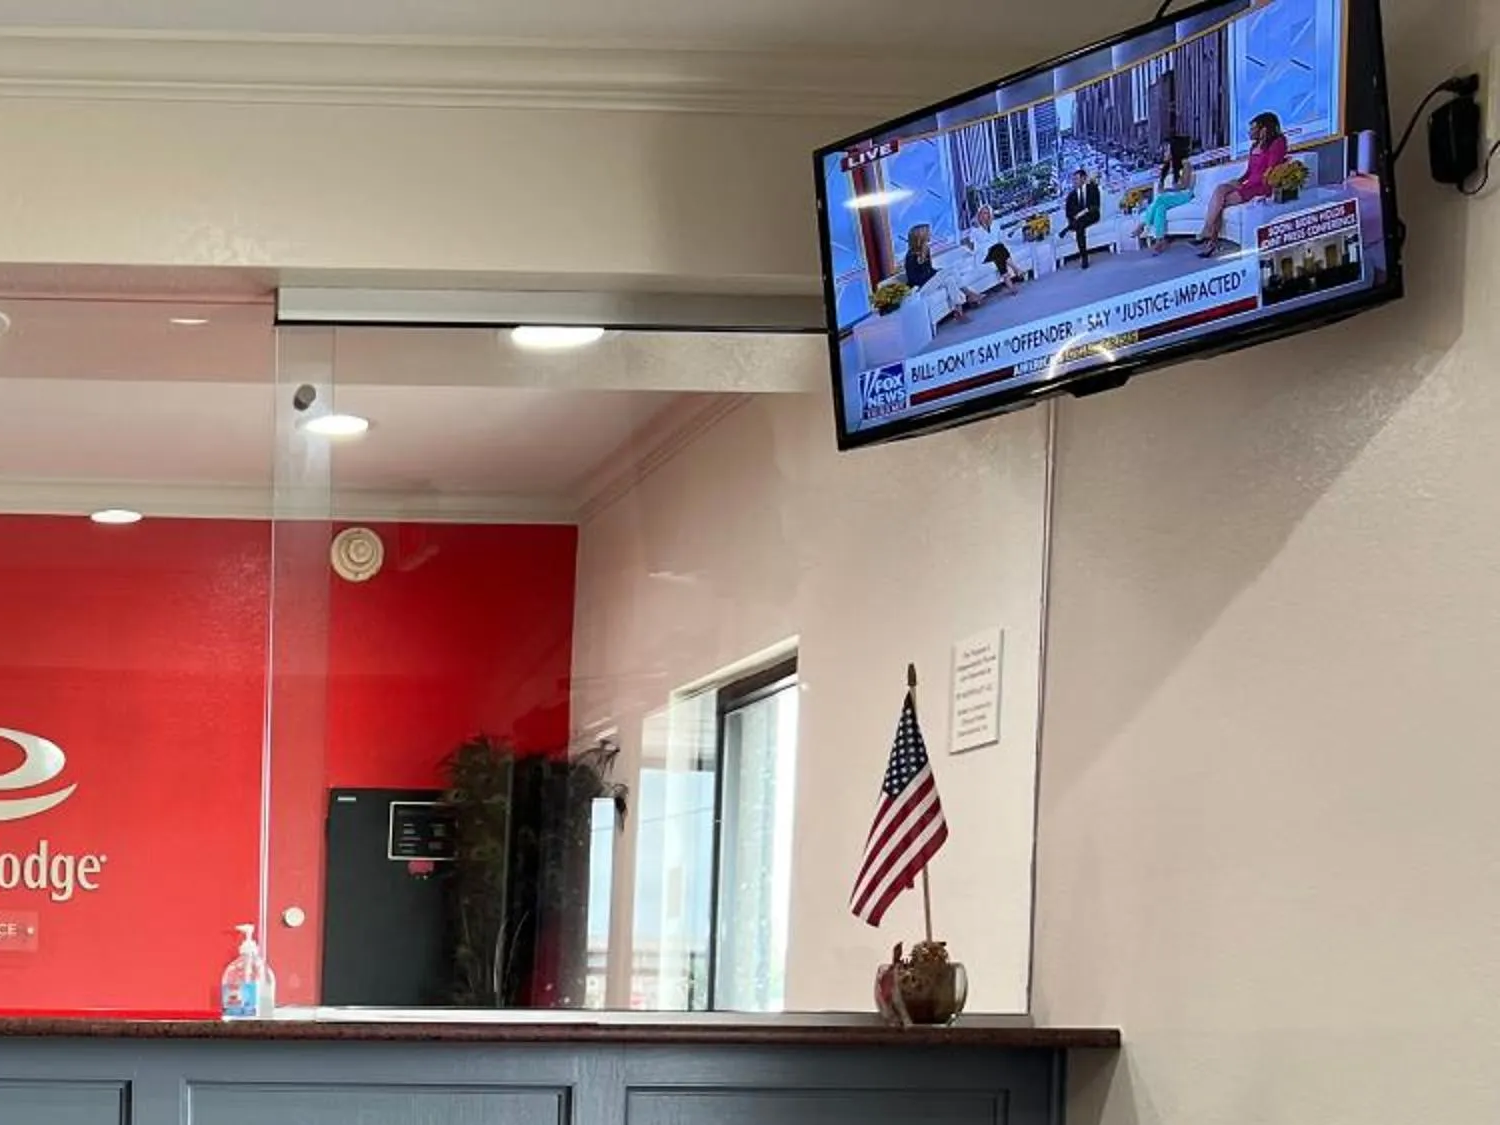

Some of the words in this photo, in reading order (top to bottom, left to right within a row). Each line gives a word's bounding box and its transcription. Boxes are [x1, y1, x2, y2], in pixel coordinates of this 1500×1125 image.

[848, 143, 892, 168] LIVE
[911, 364, 935, 383] BILL:
[938, 350, 975, 376] DON'T
[979, 342, 1001, 363] SAY
[1087, 309, 1112, 331] SAY
[1116, 269, 1247, 323] "JUSTICE-IMPACTED"
[876, 374, 903, 393] FOX
[868, 388, 905, 408] NEWS
